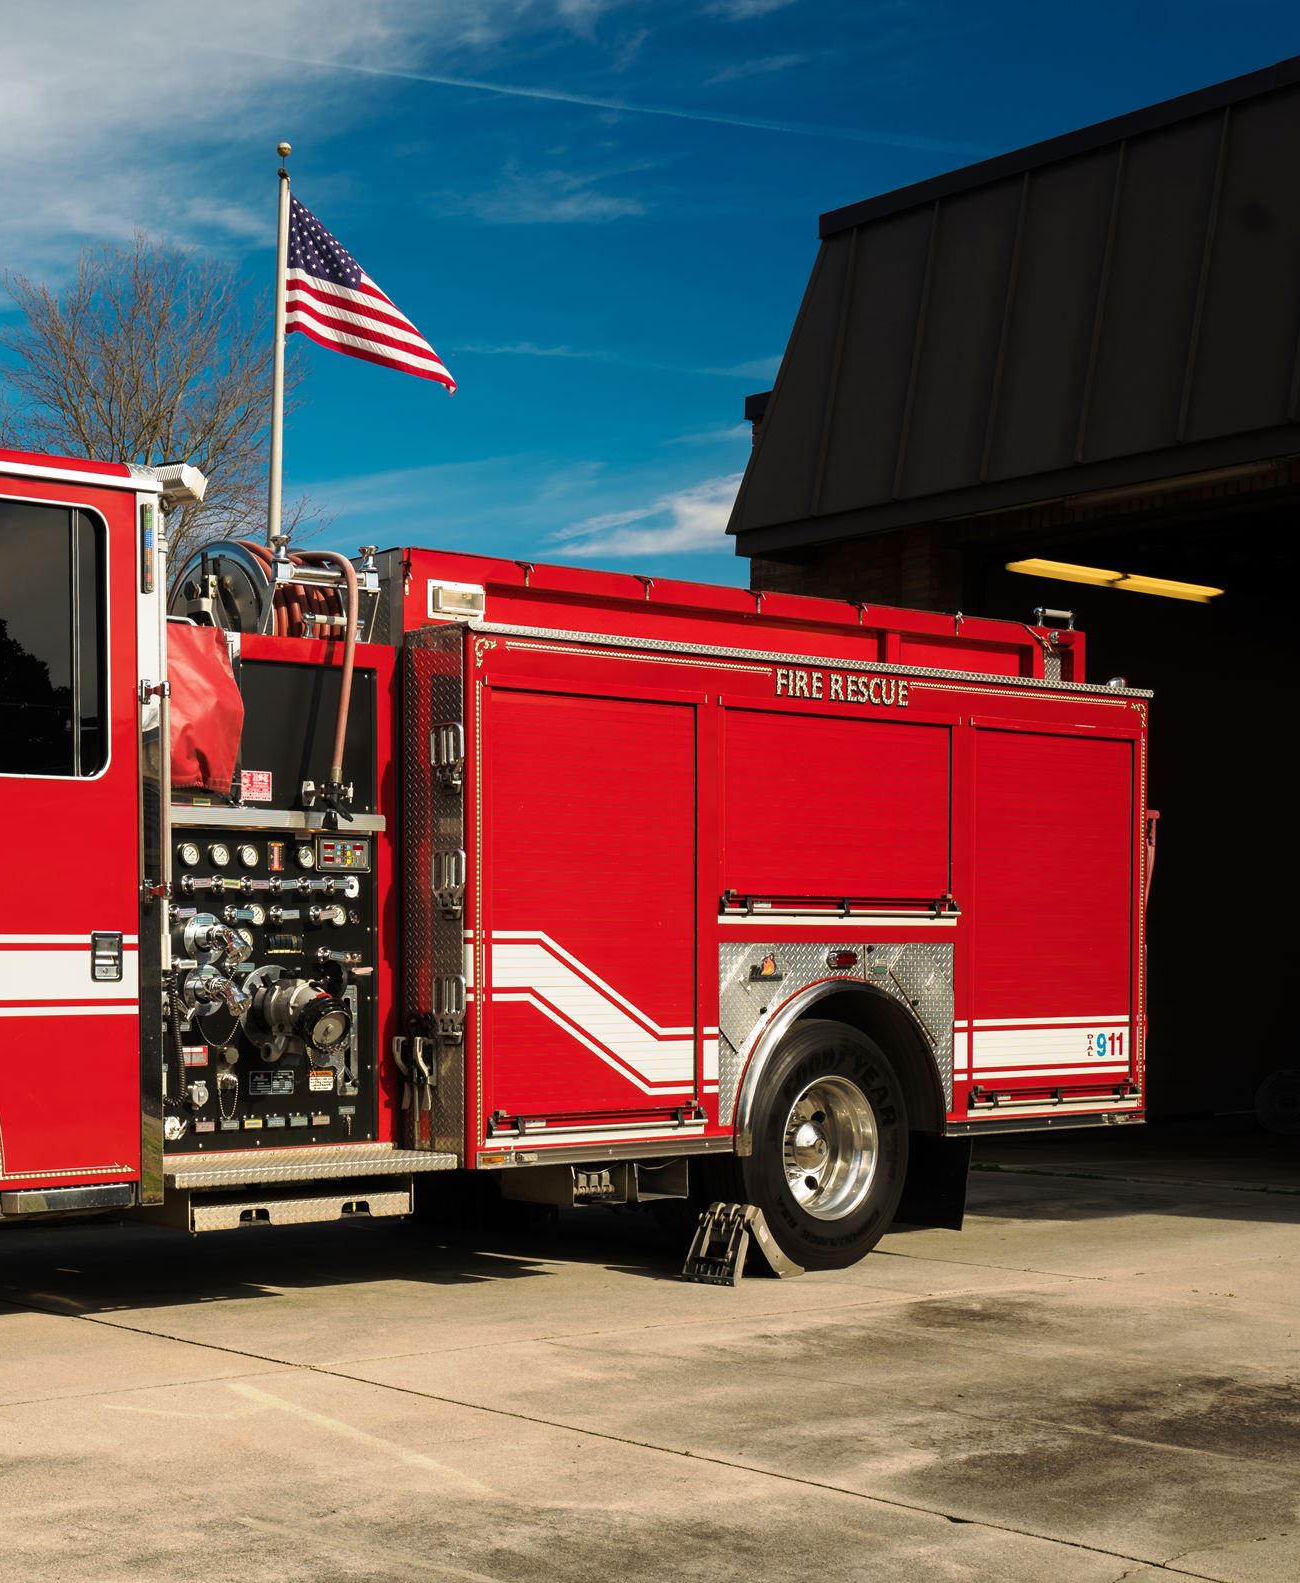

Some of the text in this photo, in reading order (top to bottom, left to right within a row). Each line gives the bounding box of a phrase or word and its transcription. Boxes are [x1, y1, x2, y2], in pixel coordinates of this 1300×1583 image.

[775, 668, 909, 707] FIRE RESCUE
[1086, 1031, 1123, 1057] DIAL 911
